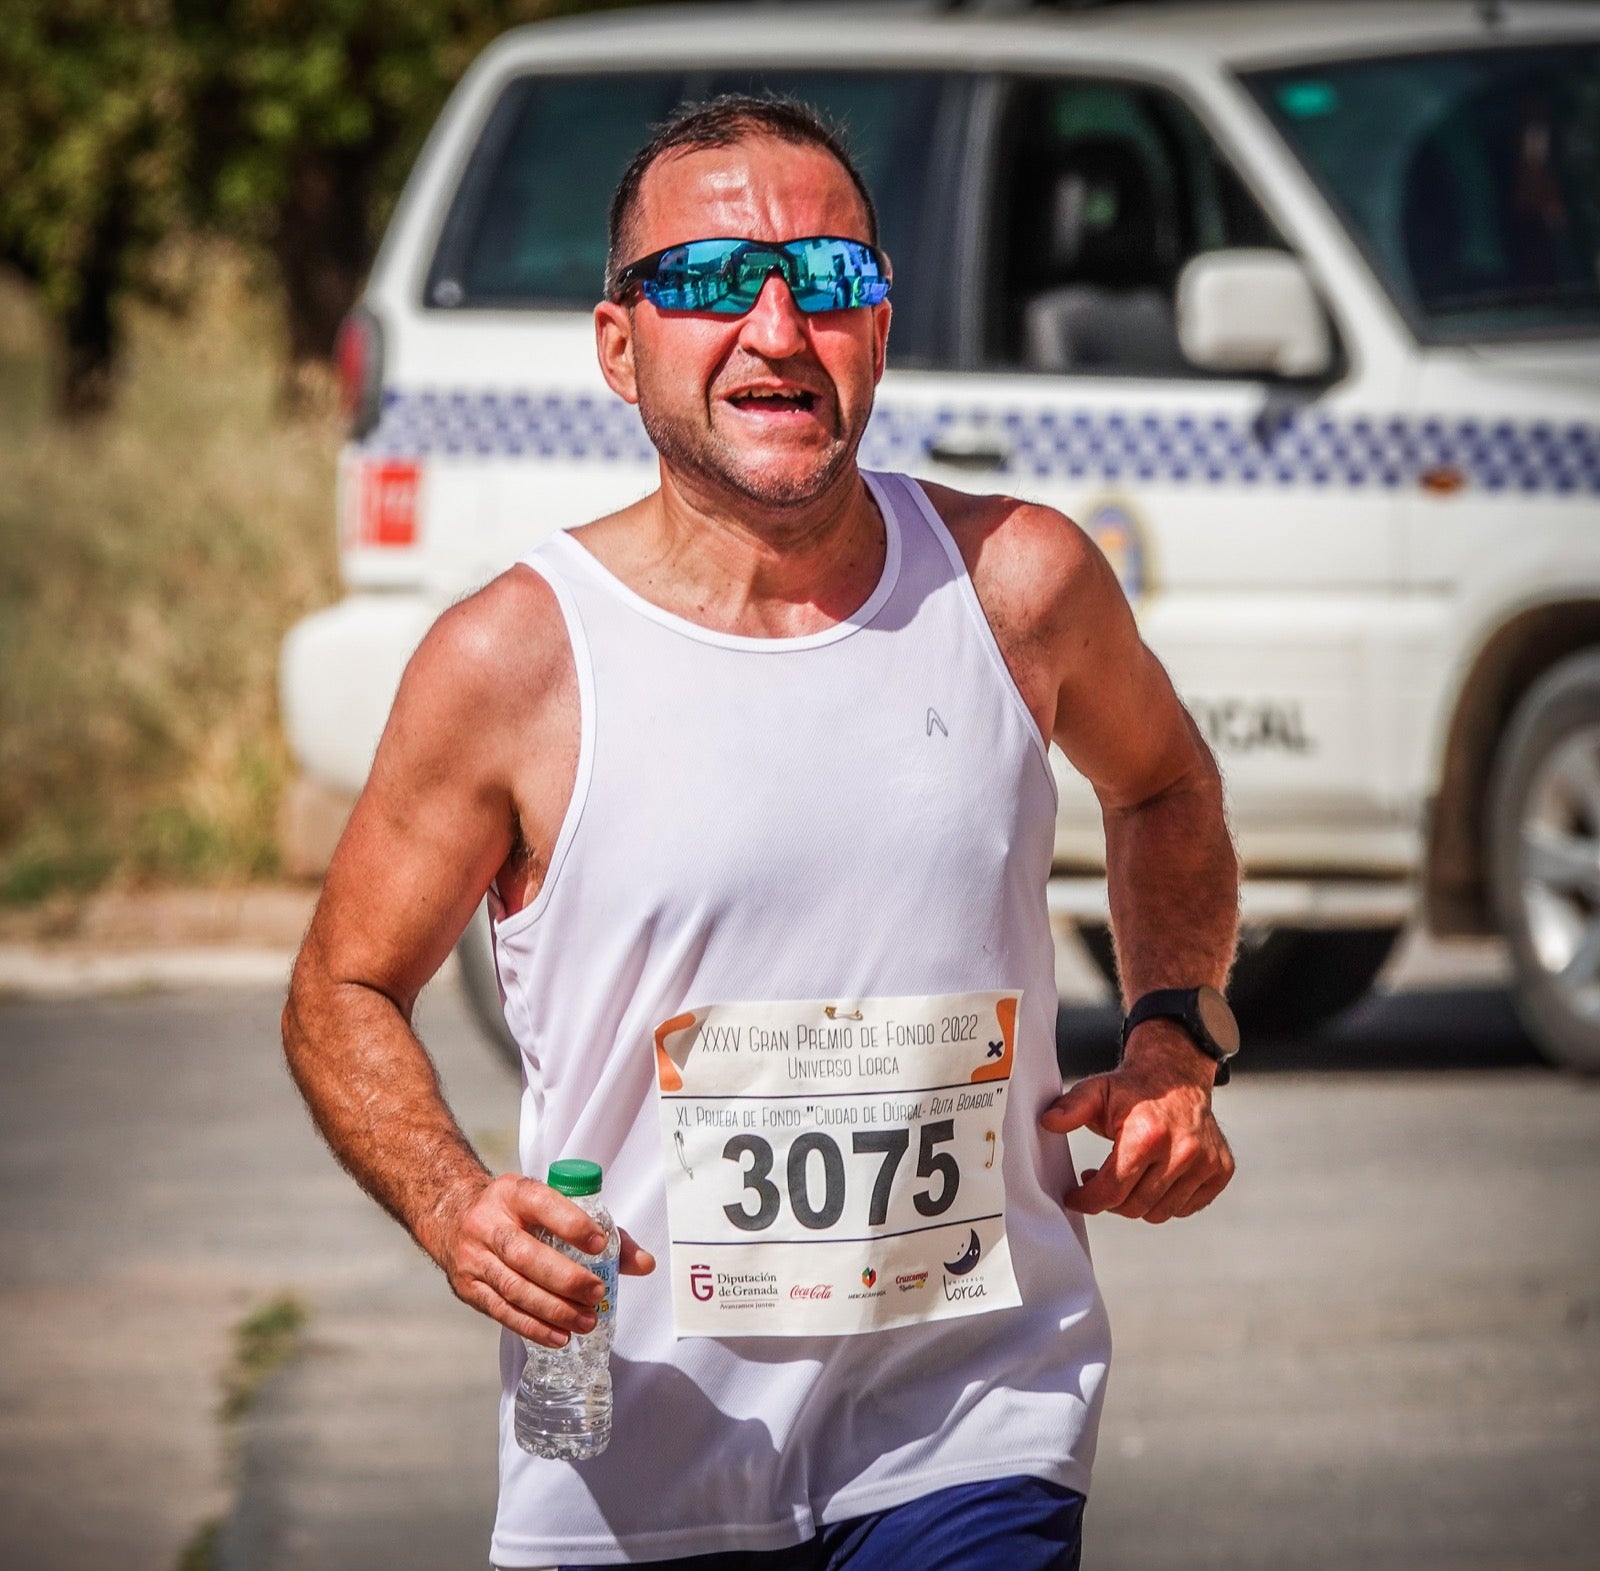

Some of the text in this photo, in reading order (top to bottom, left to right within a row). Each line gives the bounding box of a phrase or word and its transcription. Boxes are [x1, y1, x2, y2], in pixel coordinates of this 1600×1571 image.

[700, 1014, 978, 1052] XXXV GRAN PREMIO DE FONDO 2022
[787, 1055, 900, 1080] UNIVERSO LORCA
[676, 1106, 692, 1127] XL
[696, 1106, 739, 1128] PRUEBA
[743, 1111, 757, 1128] DE
[762, 1107, 801, 1128] FONDO
[863, 1106, 878, 1123] DE
[722, 1119, 960, 1231] 3075
[717, 1272, 777, 1286] Diputación
[895, 1271, 929, 1284] Cruzcampo
[718, 1284, 778, 1297] de Granada
